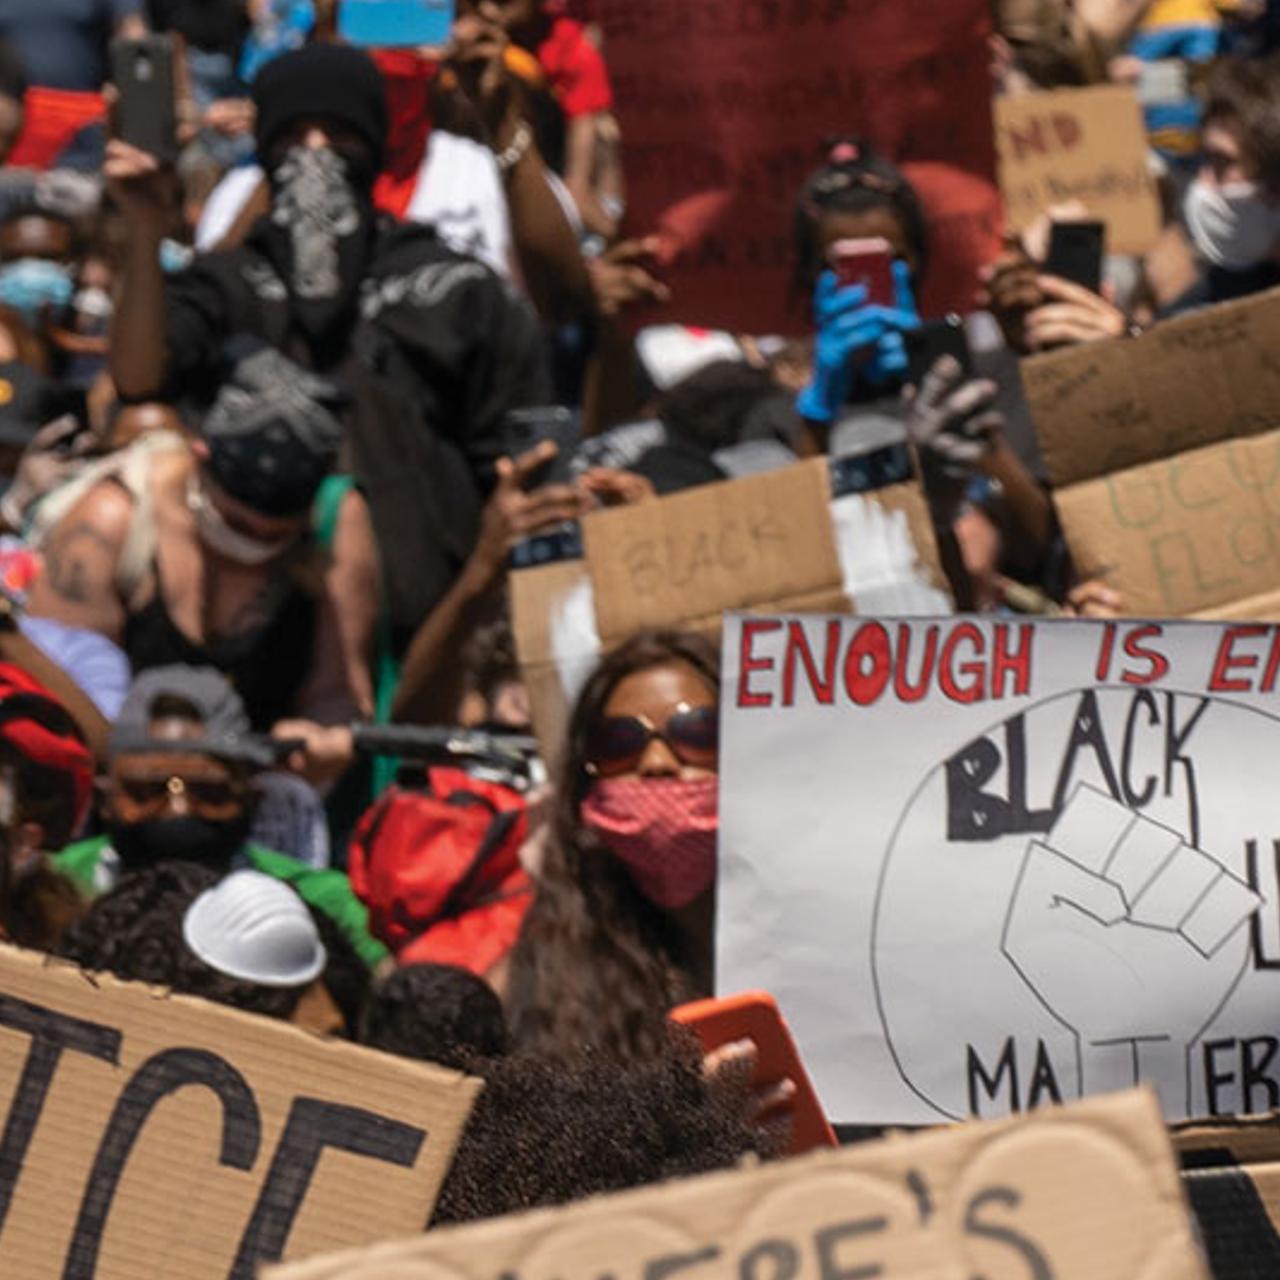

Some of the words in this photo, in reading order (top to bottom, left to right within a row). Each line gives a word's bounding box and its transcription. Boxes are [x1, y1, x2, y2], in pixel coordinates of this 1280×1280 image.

[736, 620, 1036, 708] ENOUGH
[1096, 623, 1171, 685] IS
[945, 687, 1212, 848] BLACK
